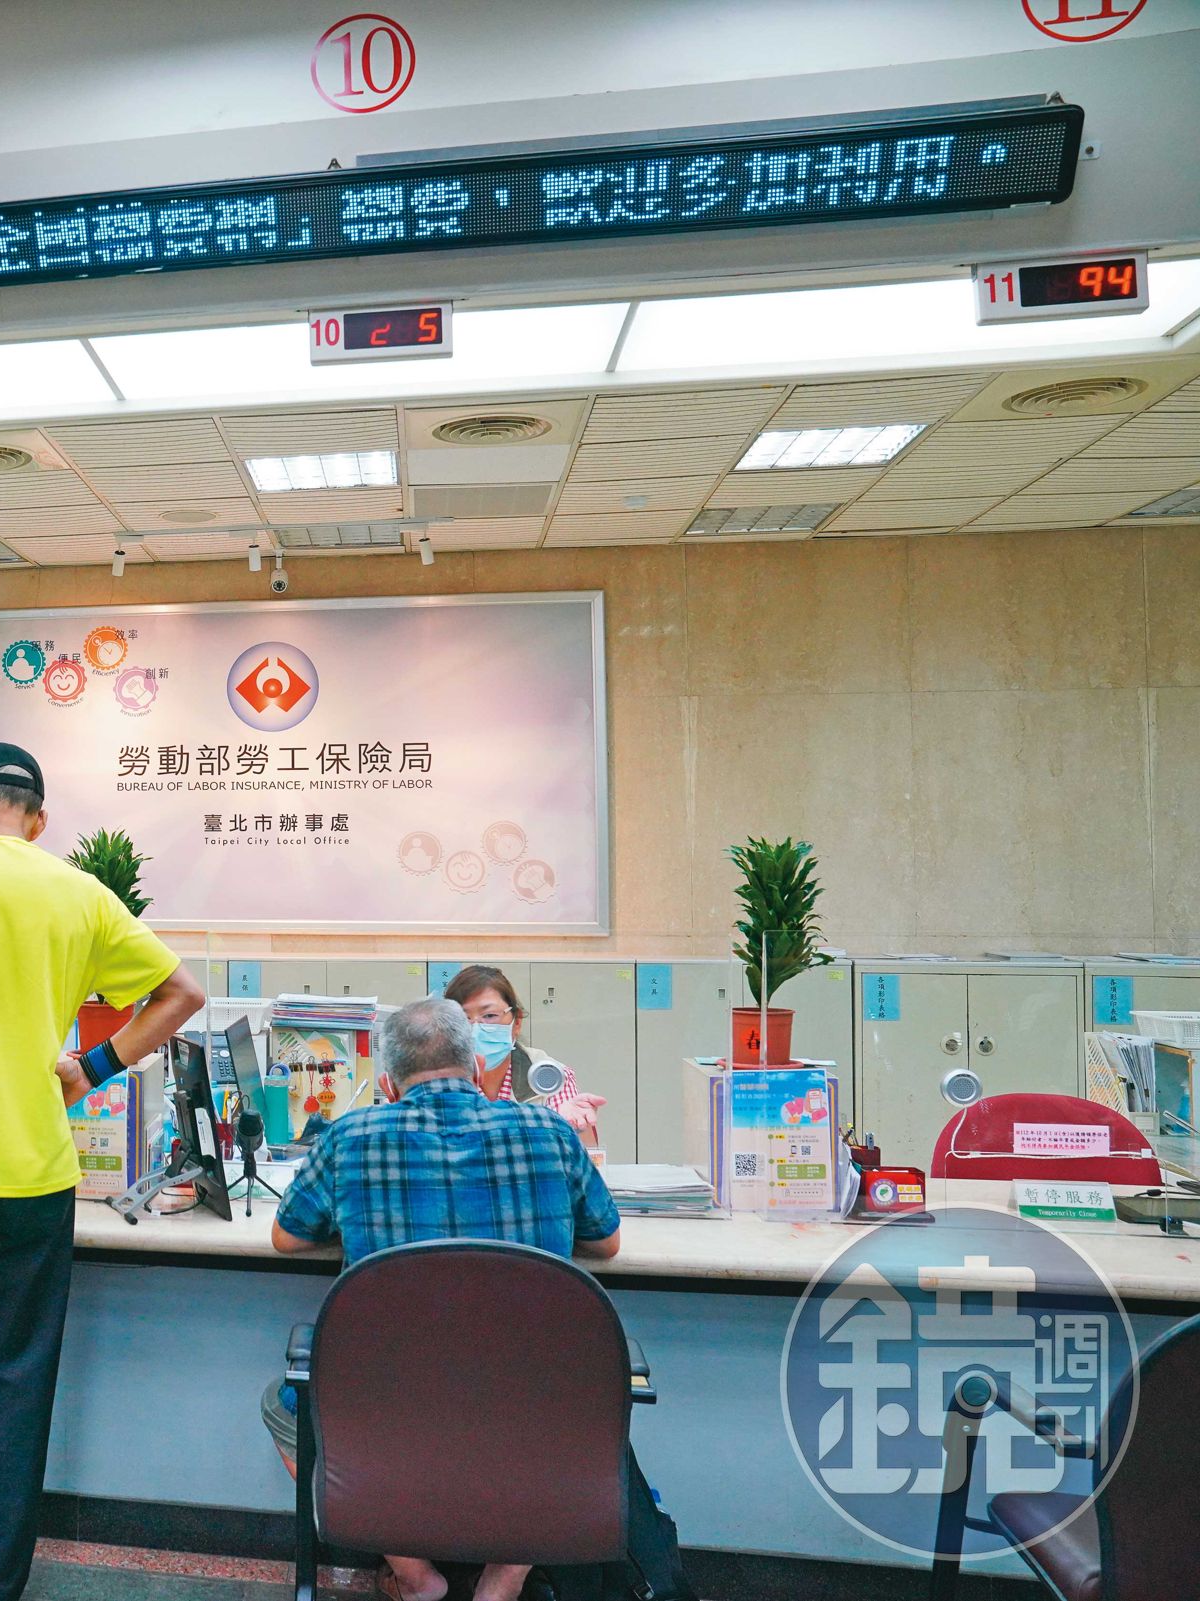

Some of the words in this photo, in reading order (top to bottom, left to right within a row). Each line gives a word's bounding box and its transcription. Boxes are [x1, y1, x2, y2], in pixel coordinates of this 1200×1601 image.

[331, 26, 401, 98] 10
[984, 272, 1013, 303] 11
[1079, 265, 1133, 297] 94
[311, 318, 340, 346] 10
[114, 629, 138, 641] 效率
[31, 640, 55, 652] 服務
[58, 653, 82, 666] 便民
[145, 667, 169, 680] 創新
[117, 741, 432, 776] 勞動部勞工保險局
[117, 782, 164, 792] BUREAU
[167, 782, 183, 791] OF
[187, 781, 227, 791] LABOR
[231, 780, 305, 792] INSURANCE,
[310, 780, 370, 790] MINISTRY
[372, 779, 389, 789] OF
[392, 778, 433, 789] LABOR
[203, 813, 350, 833] 臺北市辦事處
[204, 836, 240, 847] Taipei
[247, 836, 269, 847] City
[277, 836, 306, 845] Local
[314, 835, 350, 845] Office
[1025, 1187, 1103, 1206] 暫停服務
[1038, 1208, 1076, 1217] Temporarily
